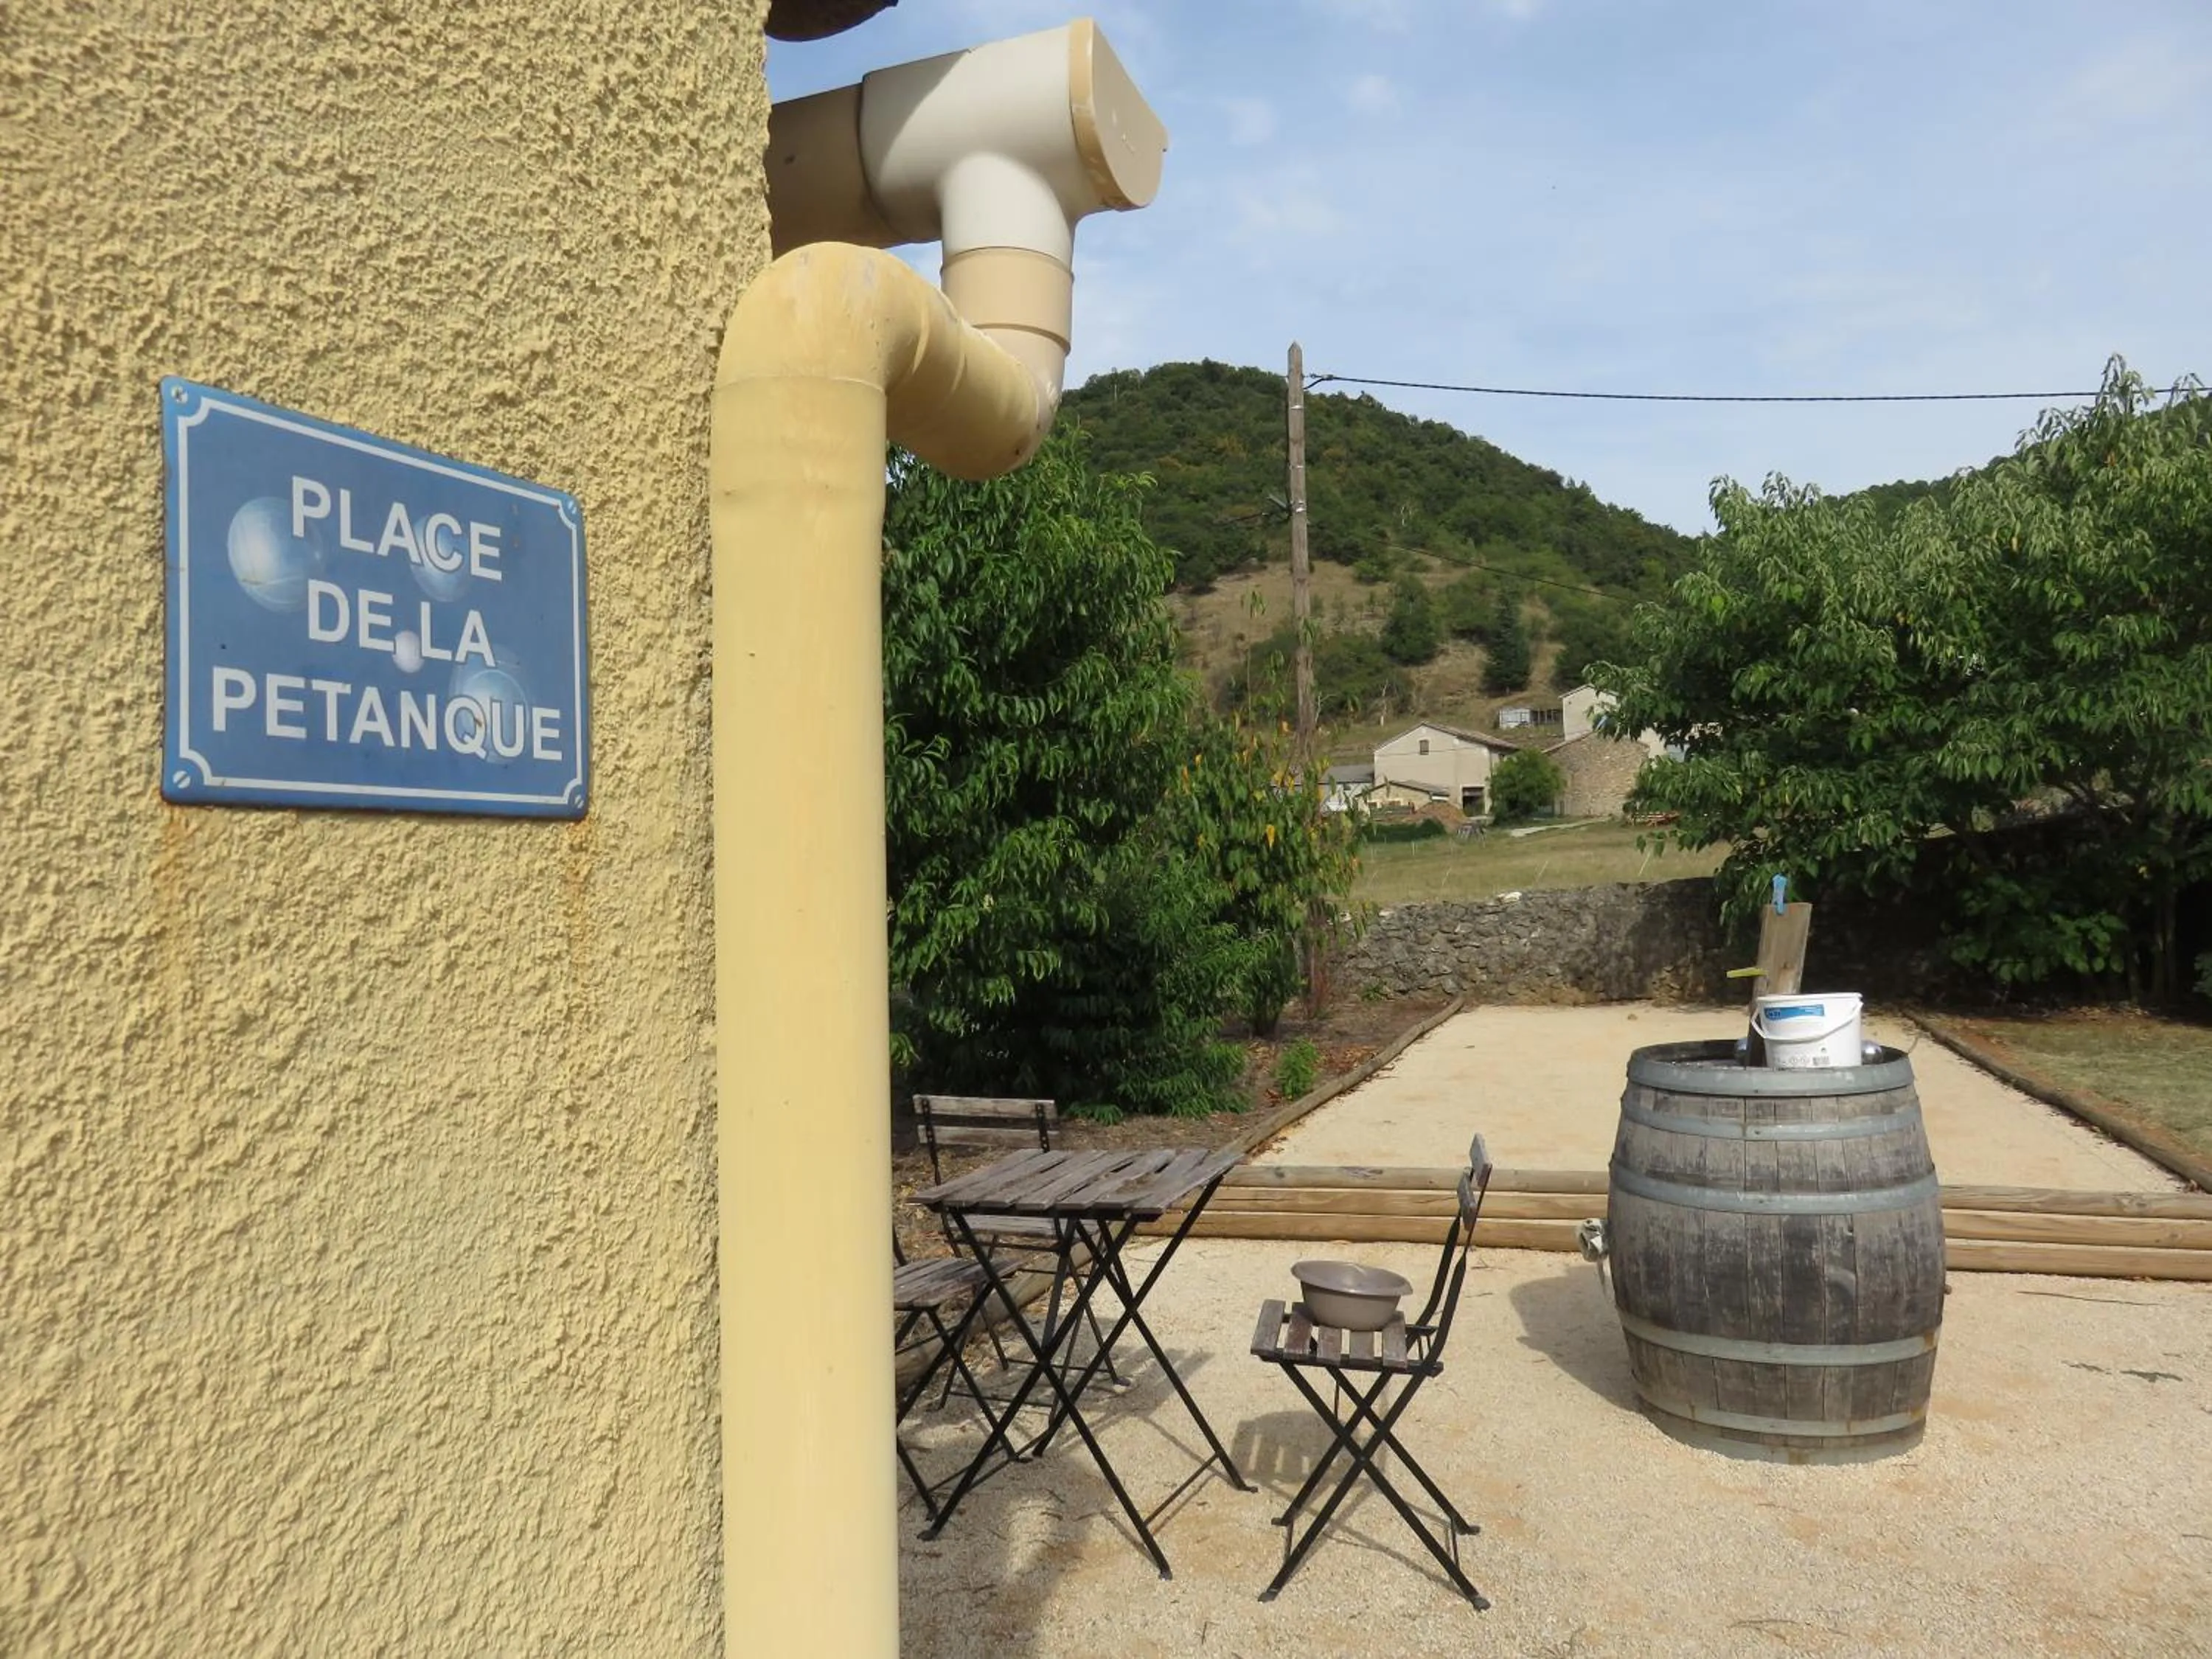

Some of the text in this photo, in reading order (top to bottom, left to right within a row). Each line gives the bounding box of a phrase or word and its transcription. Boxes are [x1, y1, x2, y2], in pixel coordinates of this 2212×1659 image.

[292, 476, 502, 581] PLACE
[307, 579, 495, 667] DE LA
[212, 666, 563, 761] PETANQUE
